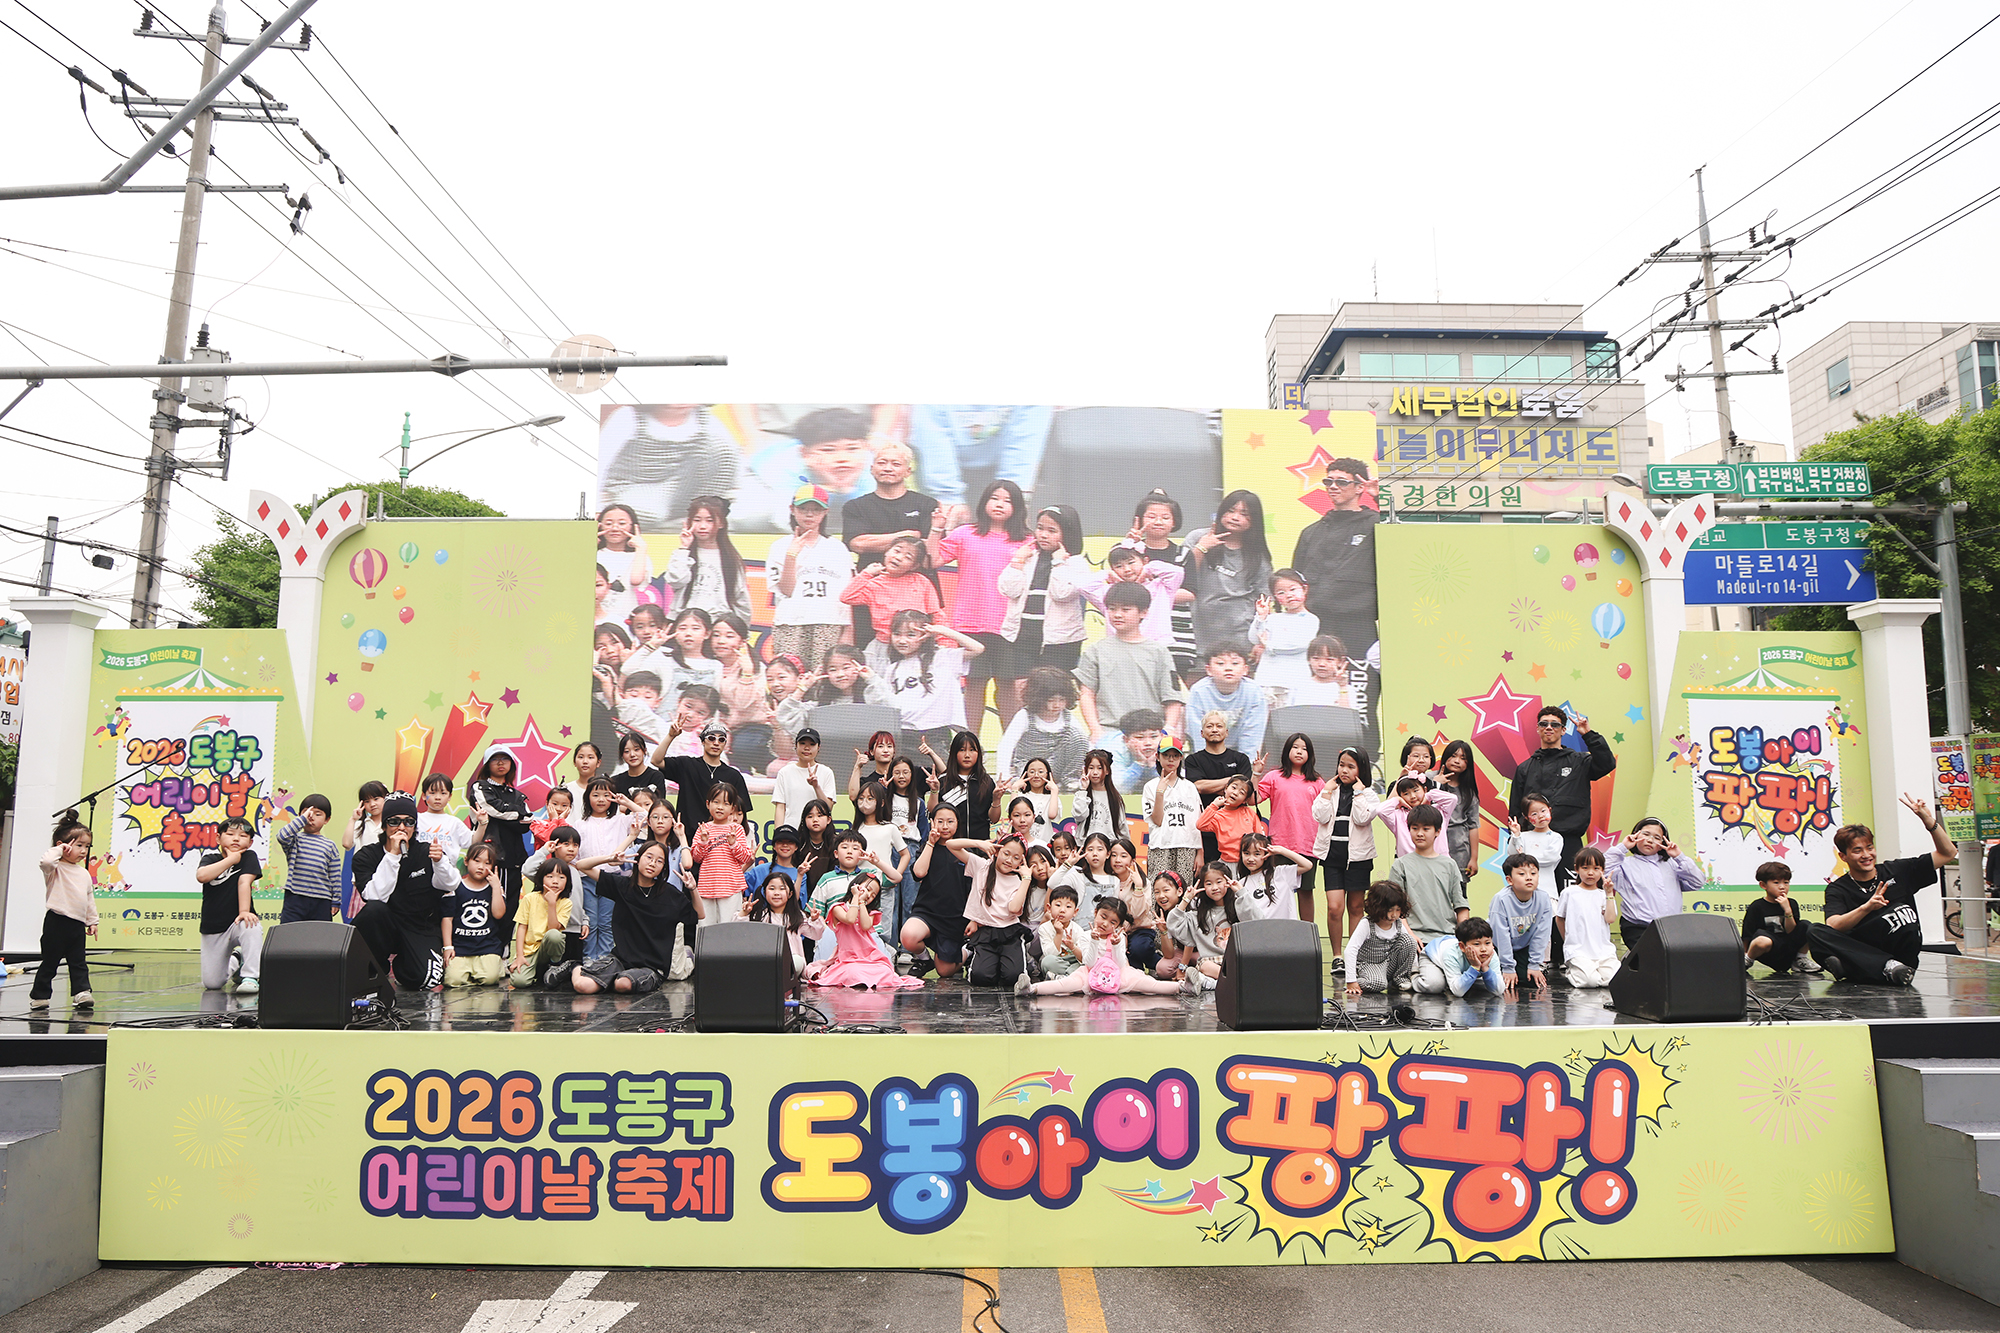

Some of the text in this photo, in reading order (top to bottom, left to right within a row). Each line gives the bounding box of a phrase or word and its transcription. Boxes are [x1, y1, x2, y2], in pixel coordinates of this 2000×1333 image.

[1657, 469, 1731, 489] 도봉구청
[1786, 527, 1850, 545] 도봉구청
[1715, 554, 1819, 579] 마들로14길
[1717, 578, 1820, 596] Madeul-ro 14-gil
[105, 649, 197, 667] 2026 도봉구 어린이날 축제
[1762, 650, 1781, 661] 2026
[1782, 649, 1804, 660] 도봉구
[1804, 652, 1833, 667] 어린이날
[127, 730, 262, 773] 2026 도봉구
[1709, 725, 1821, 774] 도봉아이
[130, 773, 255, 817] 어린이날
[1703, 770, 1831, 834] 팡팡!
[1168, 813, 1186, 827] 29
[144, 912, 164, 920] 도봉구
[1713, 904, 1731, 912] 도봉구
[369, 1072, 732, 1141] 2026 도봉구
[766, 1056, 1637, 1238] 도봉아이 팡팡!
[363, 1149, 731, 1218] 어린이날 축제
